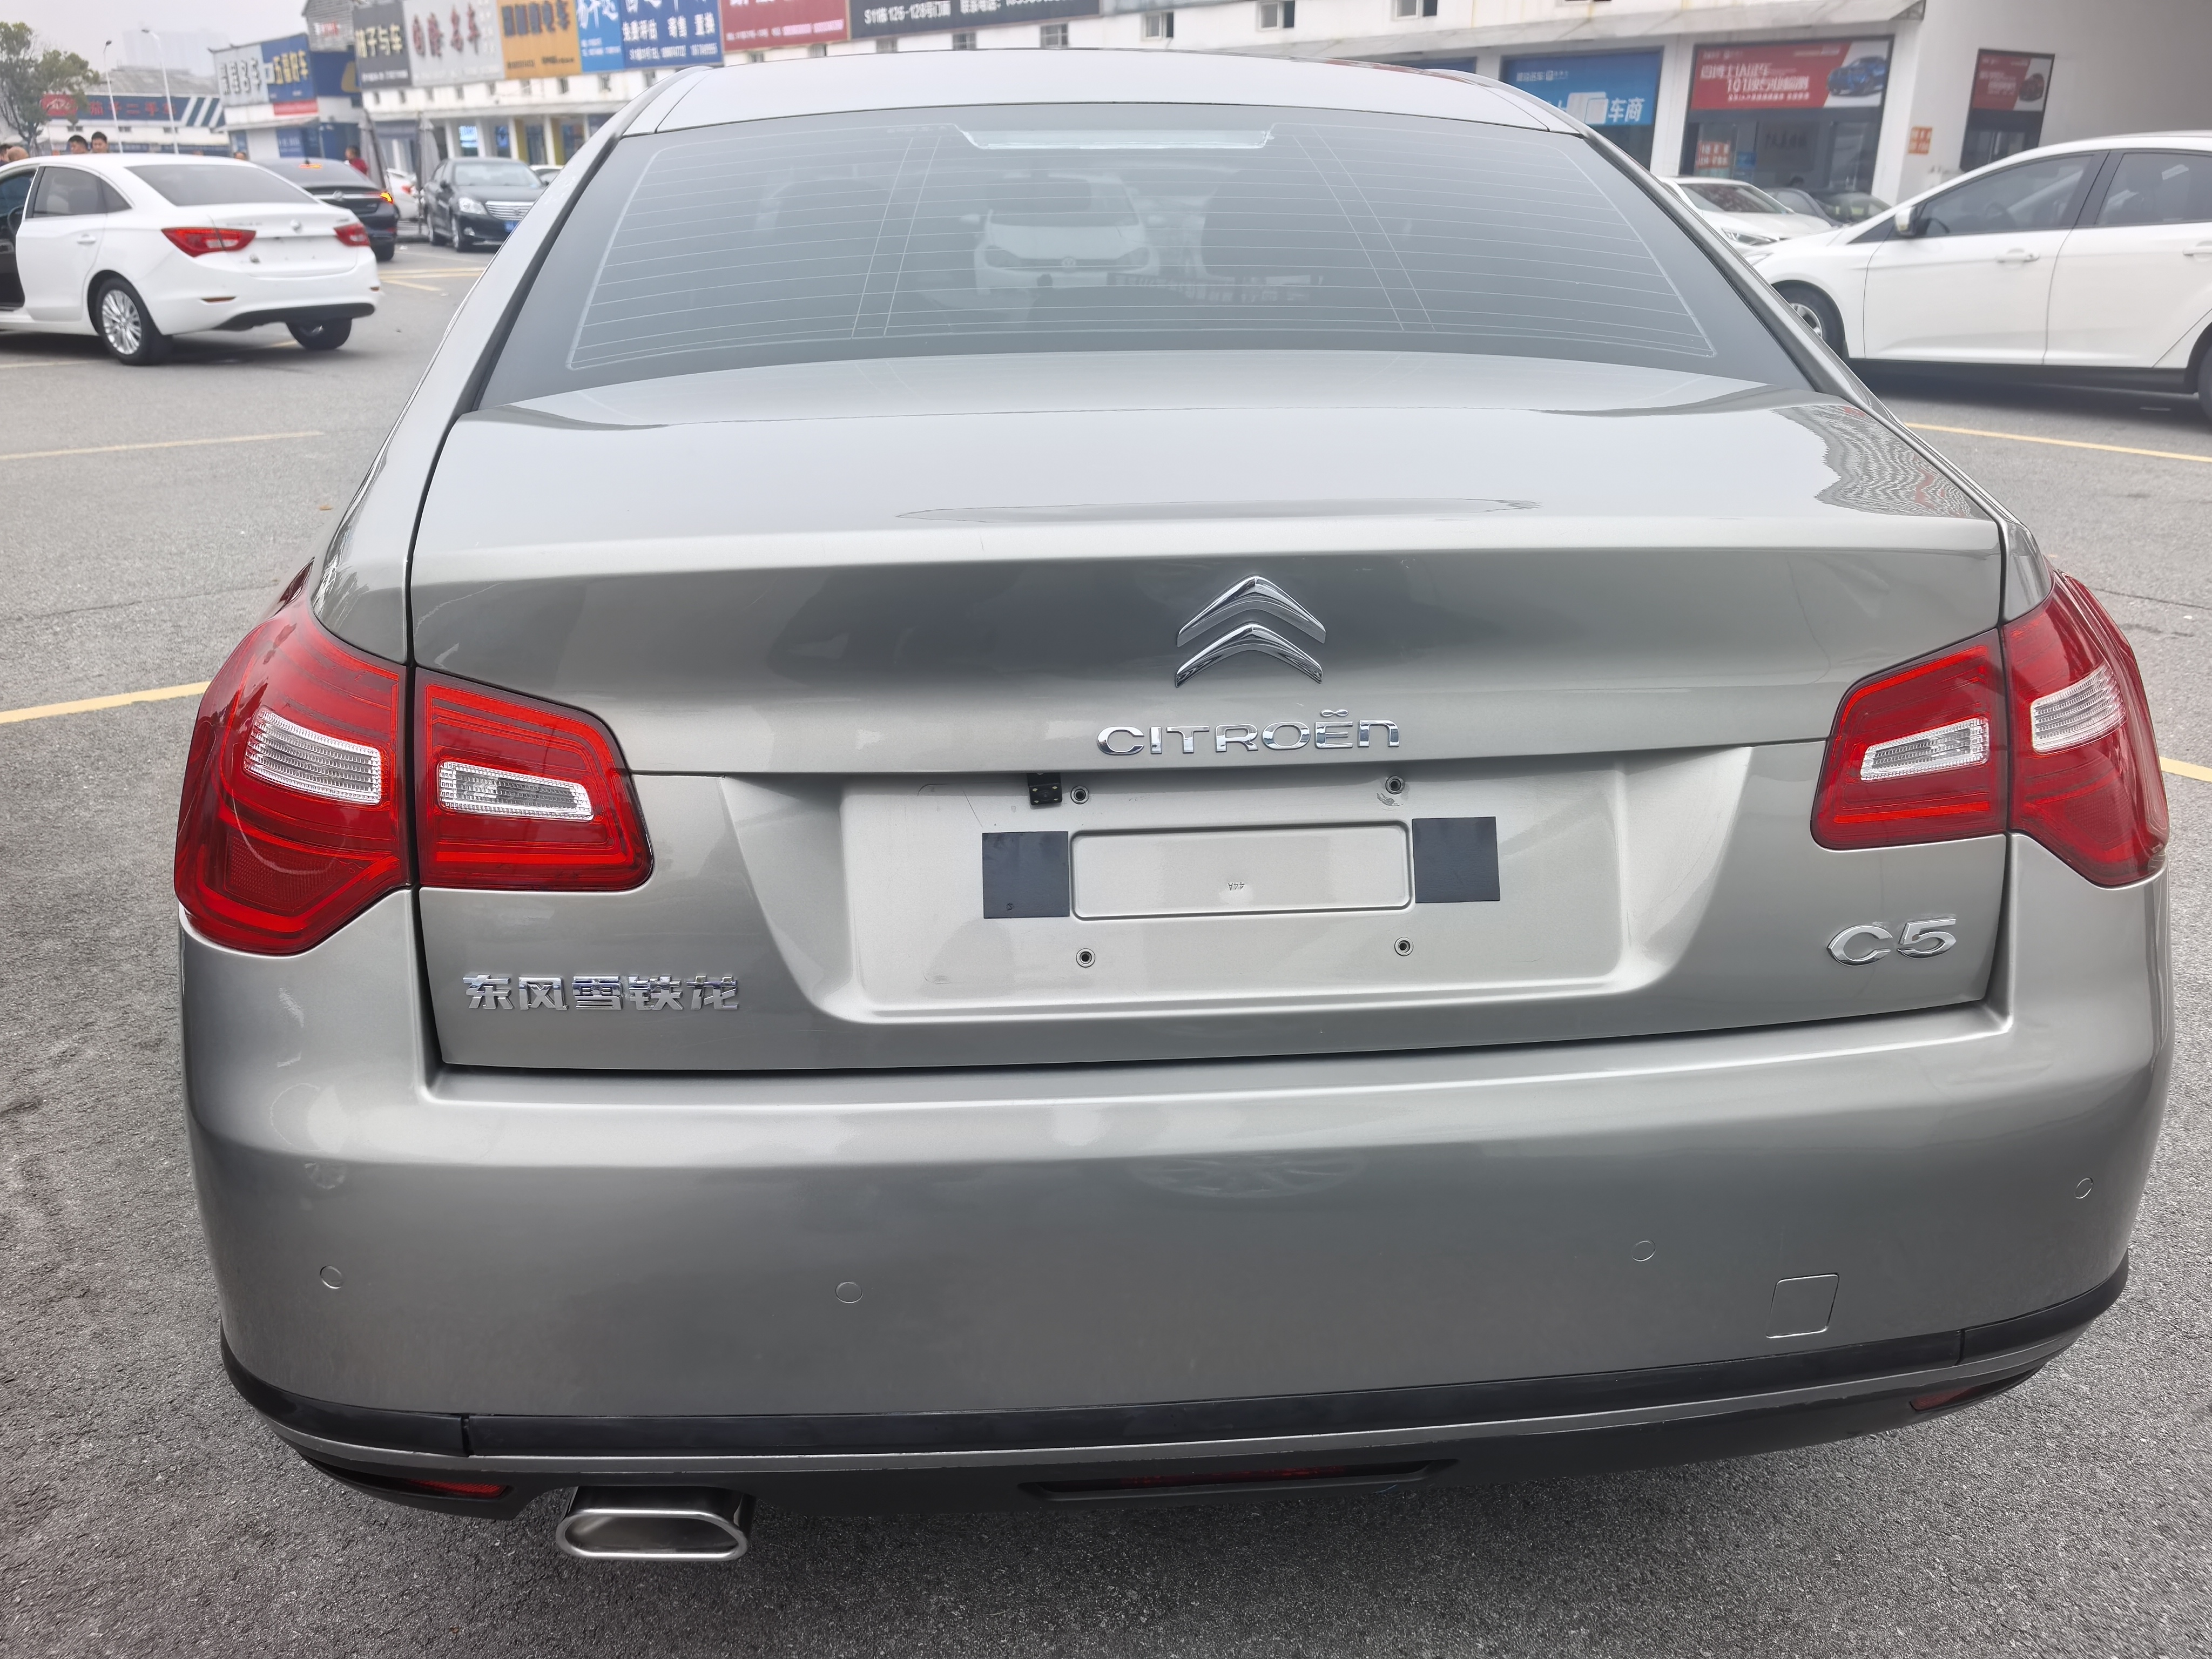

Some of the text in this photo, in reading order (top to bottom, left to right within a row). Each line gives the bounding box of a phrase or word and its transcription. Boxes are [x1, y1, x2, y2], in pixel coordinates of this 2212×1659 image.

[1608, 97, 1645, 123] 车商
[1826, 918, 1957, 967] C5
[462, 974, 739, 1011] 东风雪铁龙
